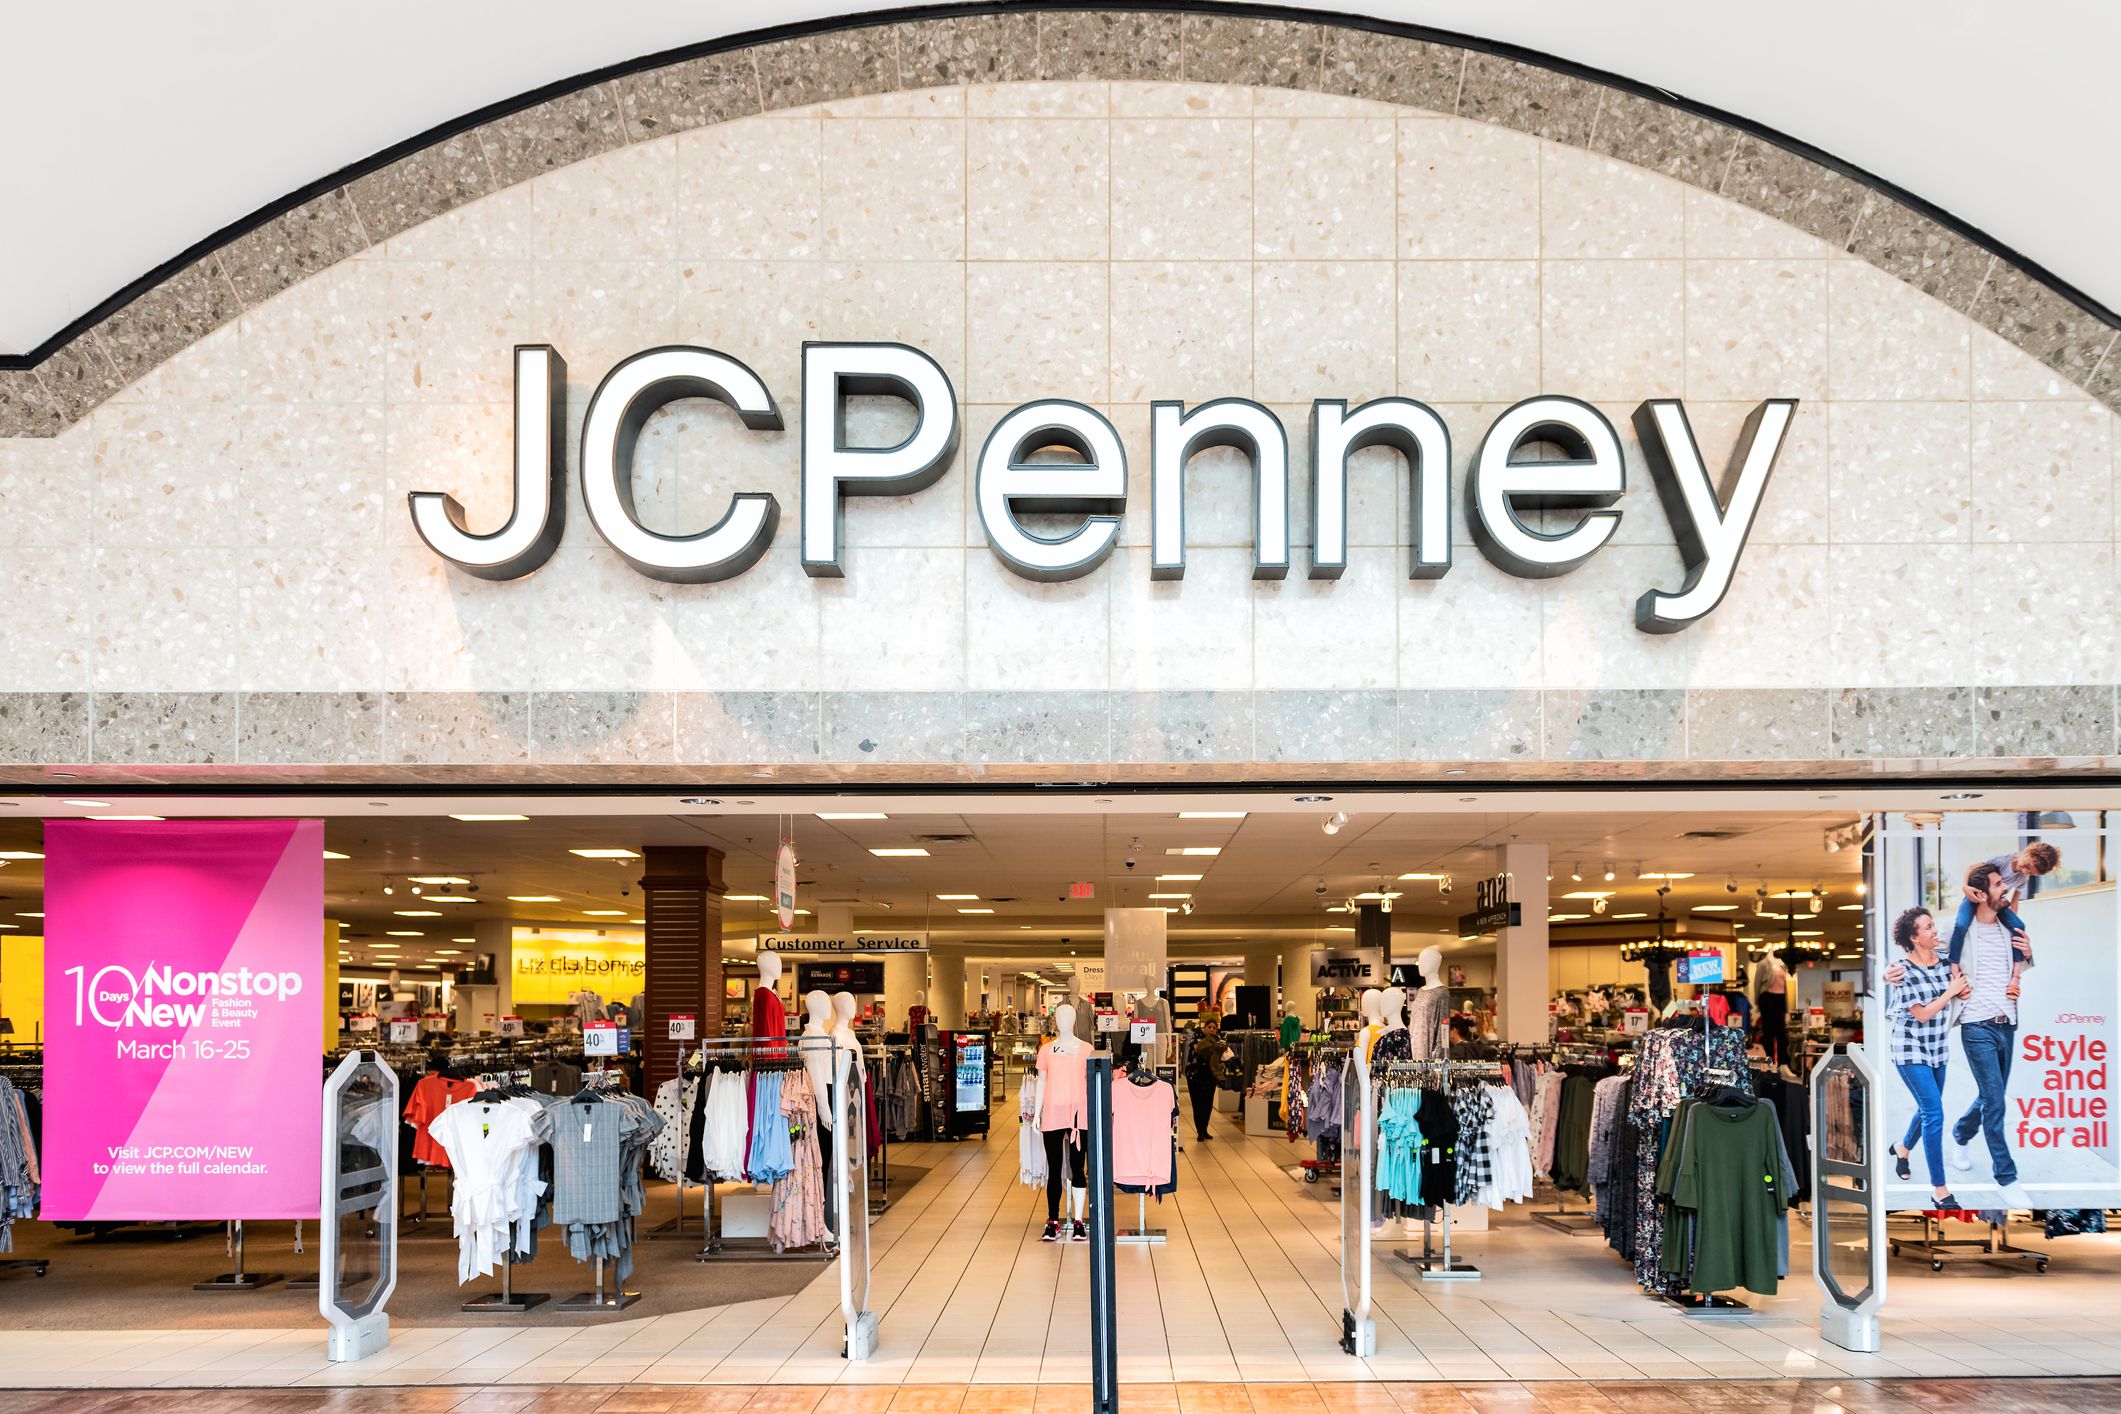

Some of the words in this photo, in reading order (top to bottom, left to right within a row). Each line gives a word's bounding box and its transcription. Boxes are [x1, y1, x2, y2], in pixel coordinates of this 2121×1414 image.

[408, 341, 1800, 633] JCPenney
[765, 937, 845, 950] Customer
[856, 936, 920, 950] Service
[1317, 964, 1372, 978] ACTIVE
[144, 965, 303, 1002] Nonstop
[64, 964, 138, 1028] 10
[99, 990, 130, 1003] Days
[211, 998, 252, 1008] Fashion
[124, 997, 207, 1028] New
[211, 1008, 219, 1018] &
[221, 1008, 259, 1019] Beauty
[211, 1018, 241, 1028] Event
[2054, 1012, 2107, 1026] JCPenney
[116, 1039, 186, 1060] March
[192, 1039, 250, 1060] 16-25
[2022, 1034, 2107, 1067] Style
[920, 1042, 931, 1103] smartwater
[2043, 1062, 2107, 1091] and
[2016, 1091, 2108, 1119] value
[2016, 1120, 2066, 1148] for
[2071, 1120, 2108, 1148] all
[107, 1145, 141, 1160] Visit
[143, 1144, 254, 1161] JCP.COM/NEW
[92, 1162, 109, 1175] to
[112, 1161, 147, 1175] view
[150, 1161, 175, 1175] the
[177, 1161, 200, 1175] full
[203, 1161, 268, 1175] calendar.
